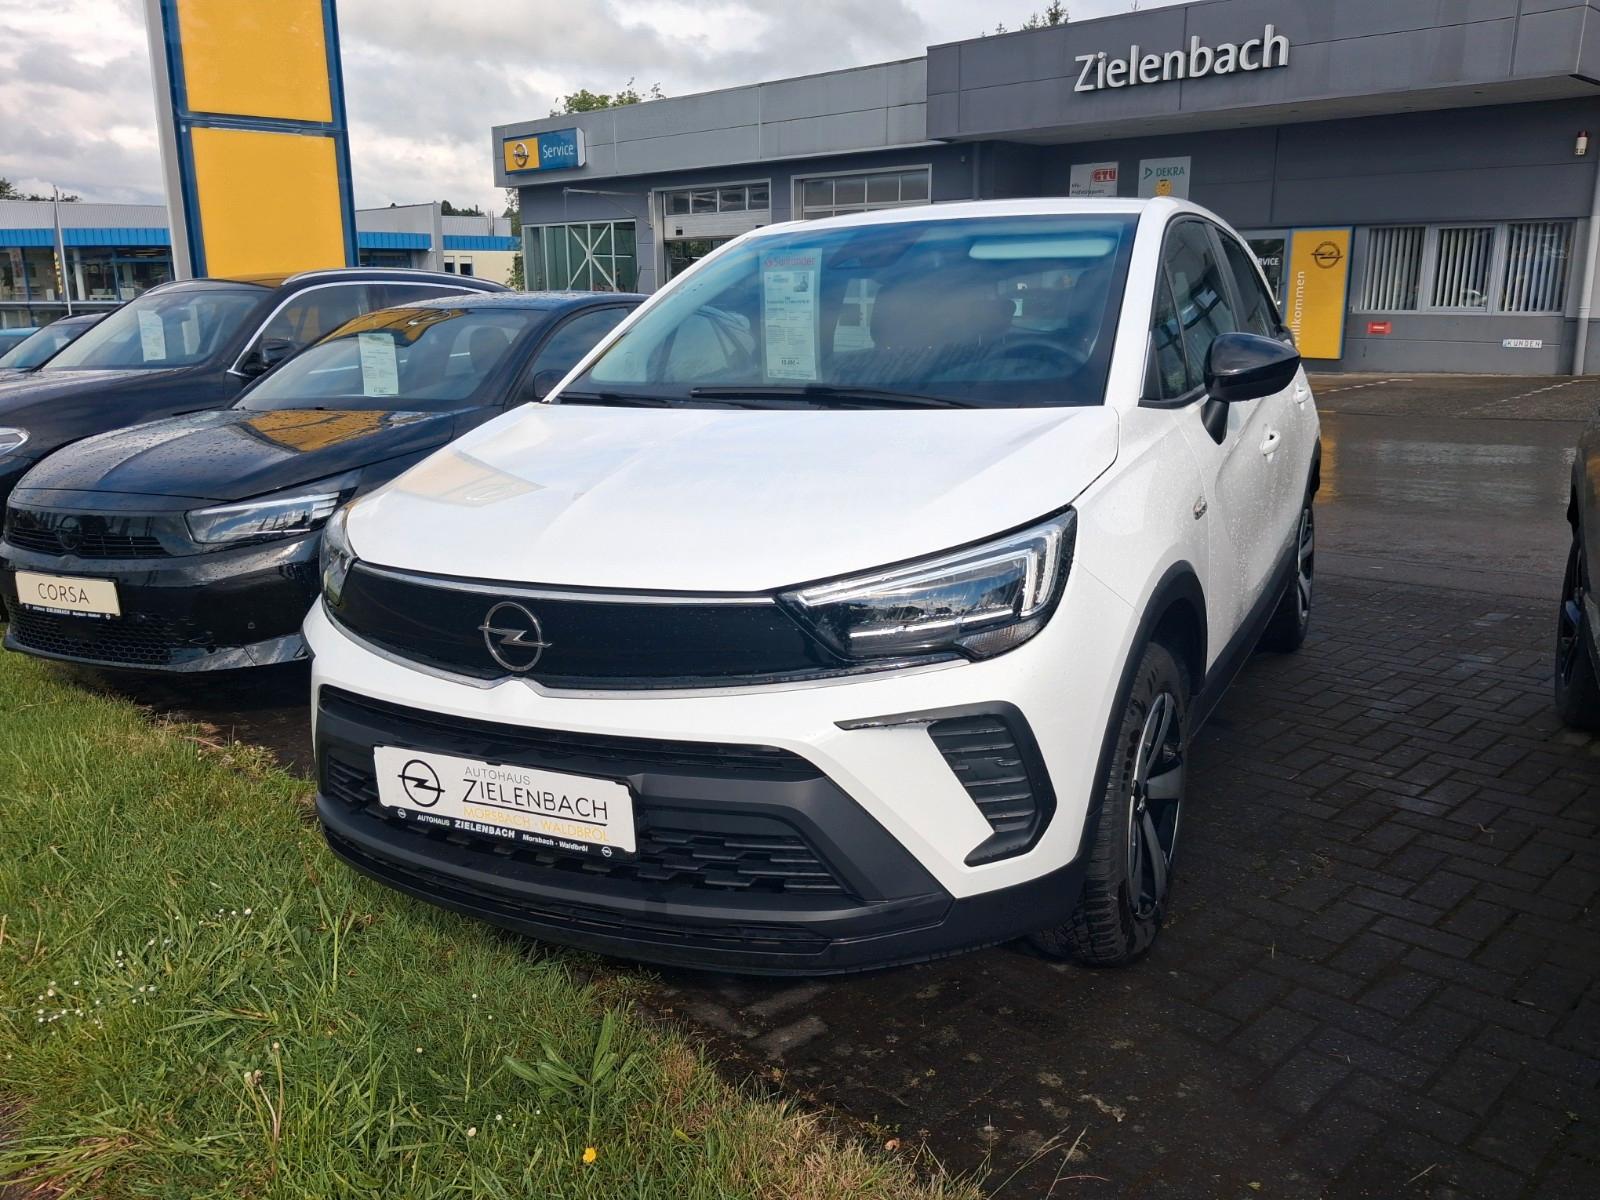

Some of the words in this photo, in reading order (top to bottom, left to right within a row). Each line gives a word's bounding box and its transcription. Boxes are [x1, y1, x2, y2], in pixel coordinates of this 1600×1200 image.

[1074, 24, 1290, 92] Zielenbach
[542, 142, 574, 159] Service
[1156, 166, 1185, 177] DEKRA
[1258, 257, 1280, 266] RVICE
[37, 583, 90, 604] CORSA
[464, 766, 531, 785] AUTOHAUS
[462, 778, 608, 820] ZIELENBACH
[463, 806, 530, 829] MORSBACH
[417, 814, 450, 826] AUTOHAUS
[454, 819, 516, 838] ZIELENBACH
[522, 834, 554, 846] Morsbach
